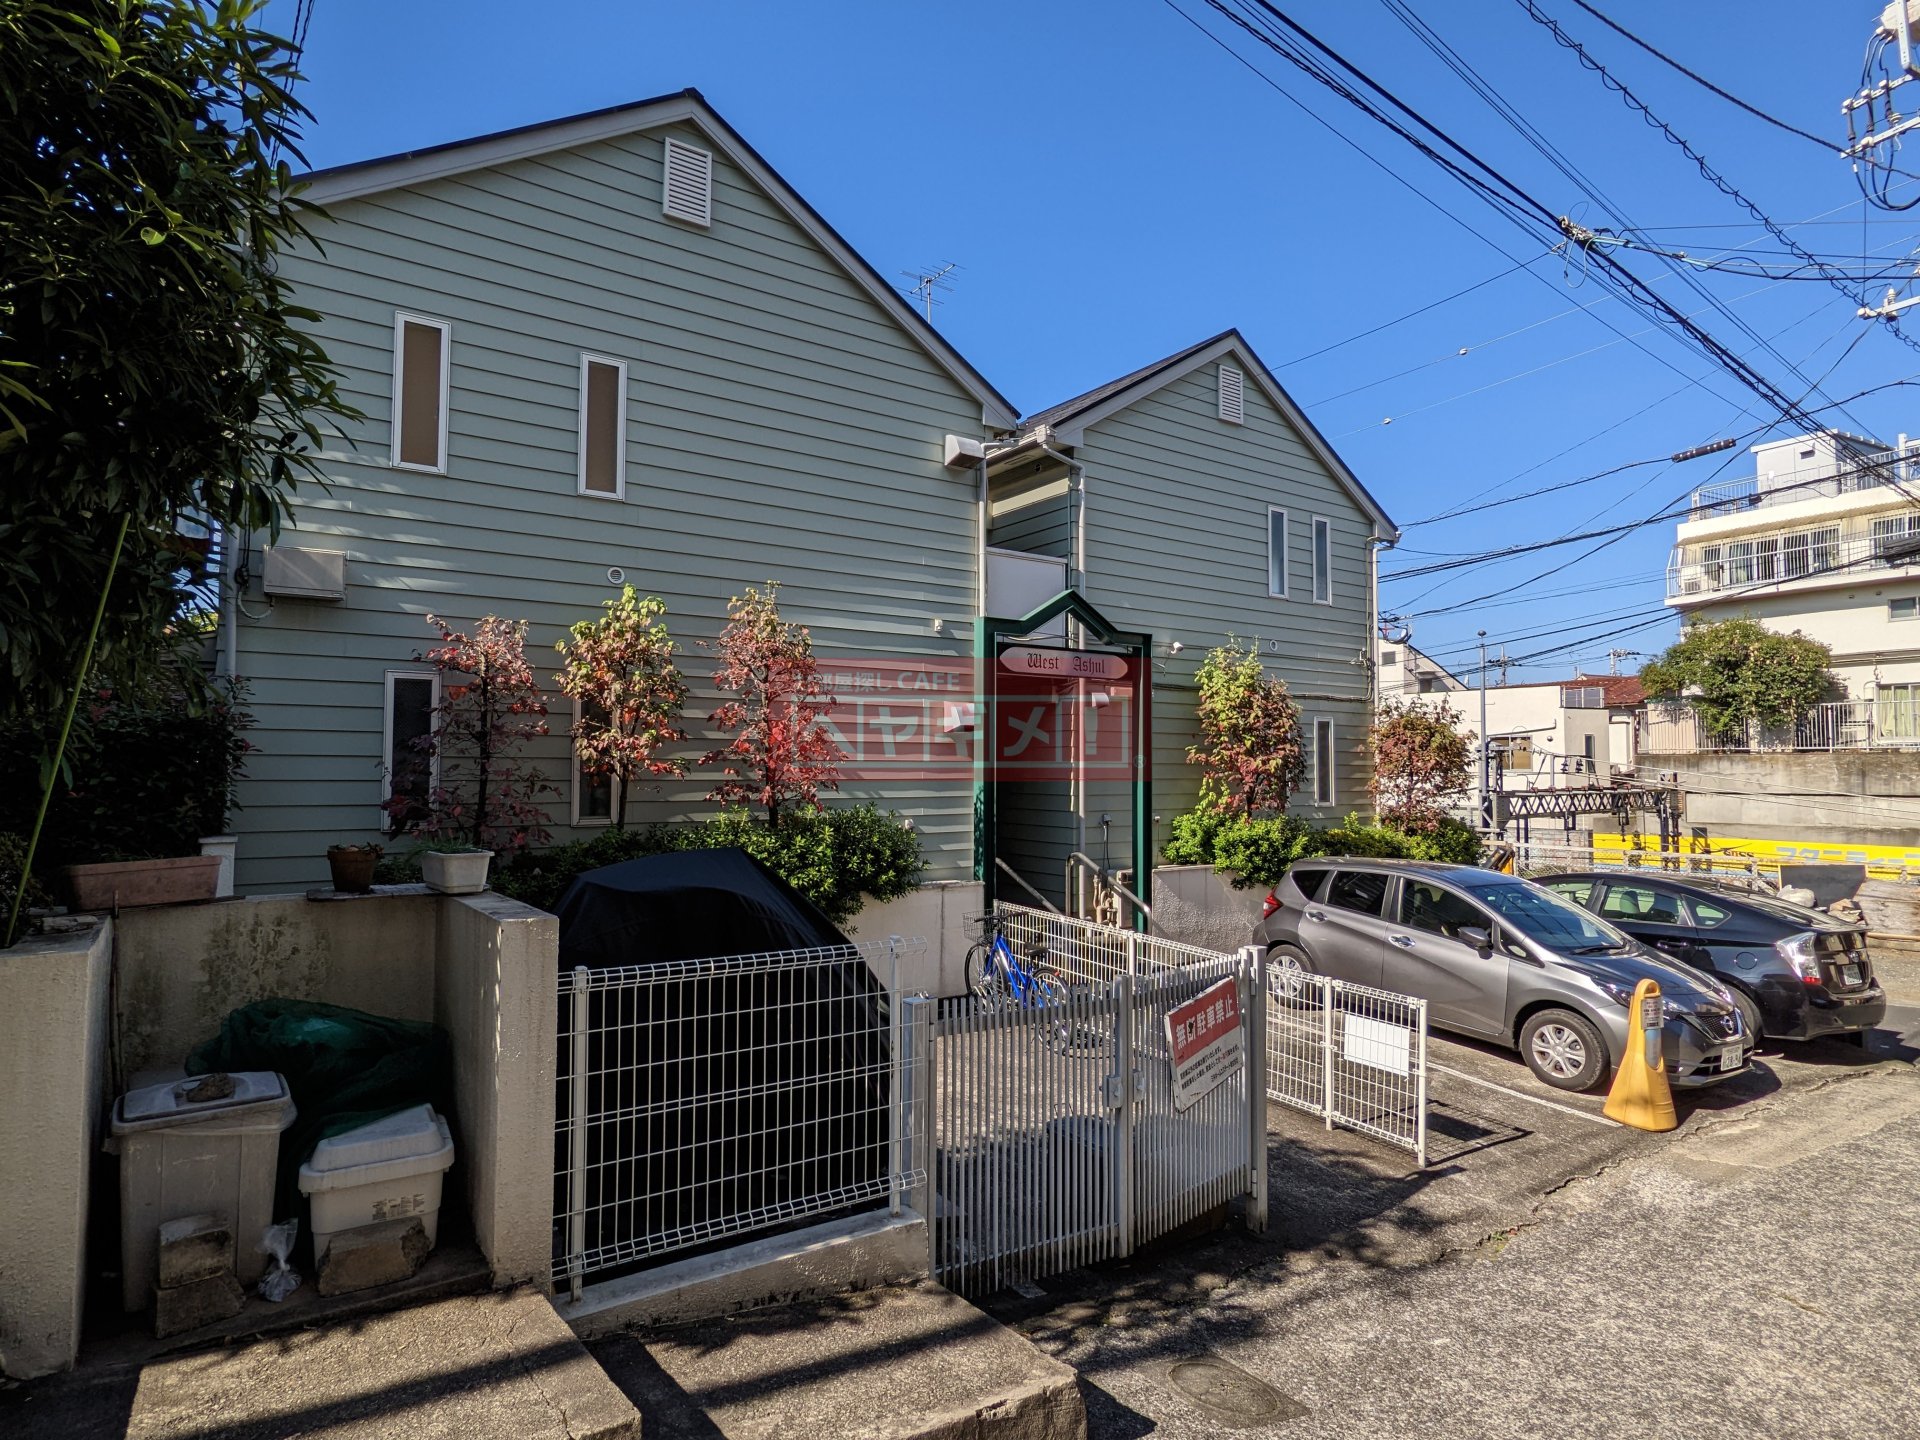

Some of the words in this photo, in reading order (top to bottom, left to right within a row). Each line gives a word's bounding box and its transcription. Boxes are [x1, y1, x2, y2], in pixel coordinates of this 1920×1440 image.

[1027, 653, 1059, 670] West
[1176, 994, 1234, 1050] 無断駐車禁止
